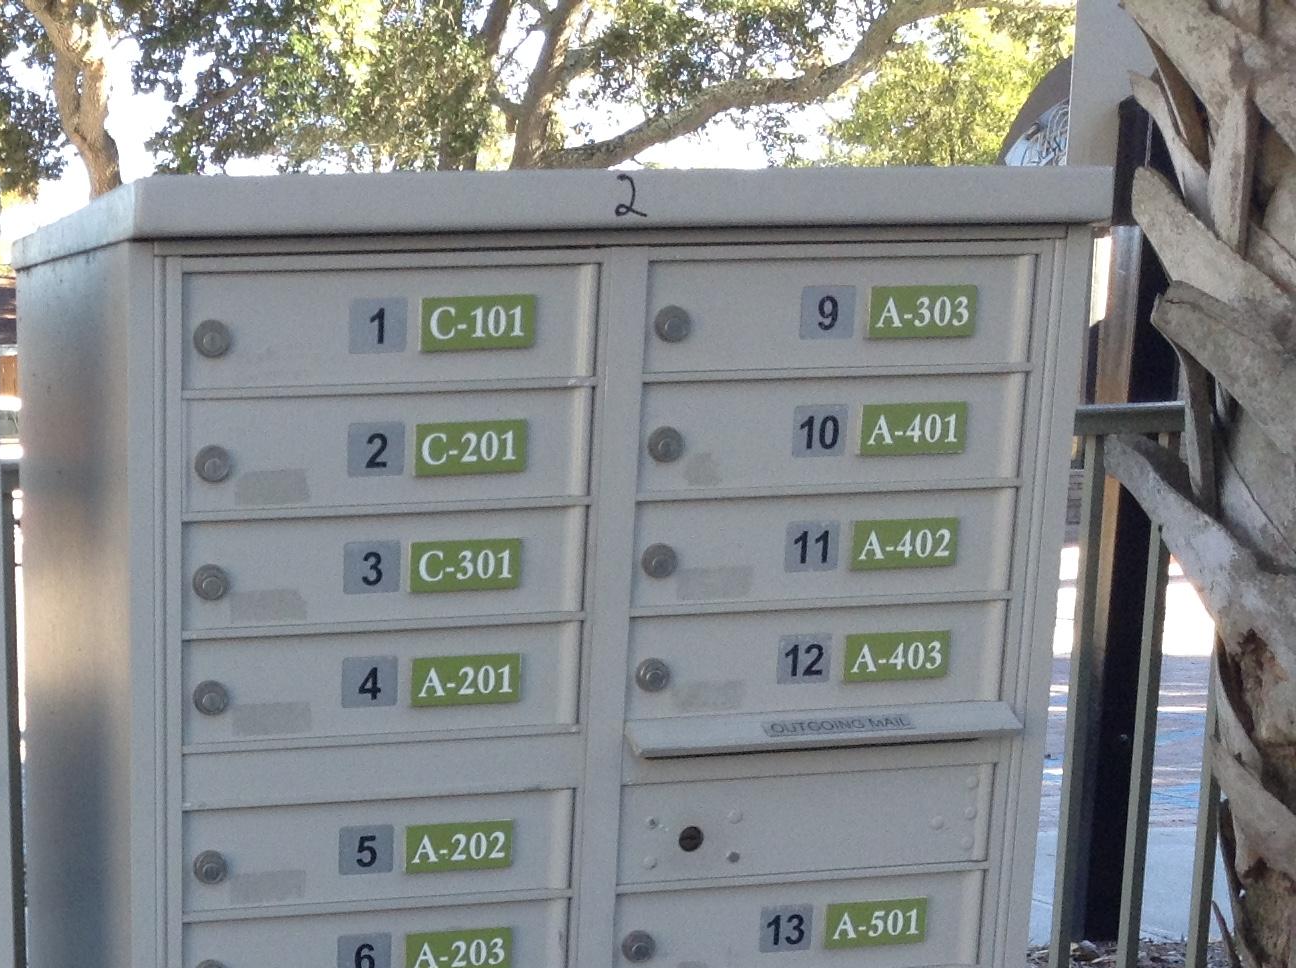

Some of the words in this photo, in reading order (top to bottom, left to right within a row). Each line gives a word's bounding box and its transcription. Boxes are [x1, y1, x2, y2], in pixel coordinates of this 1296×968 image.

[615, 173, 647, 217] 2
[369, 307, 385, 345] 1
[429, 305, 524, 340] C-101
[817, 295, 839, 331] 9
[876, 296, 969, 328] A-303
[799, 414, 840, 450] 10
[867, 413, 958, 445] A-401
[365, 432, 388, 469] 2
[421, 430, 516, 465] C-201
[793, 529, 830, 564] 11
[858, 528, 951, 560] A-402
[361, 551, 383, 587] 3
[418, 549, 512, 582] C-301
[784, 643, 824, 677] 12
[850, 640, 942, 673] A-403
[358, 666, 382, 701] 4
[418, 664, 513, 698] A-201
[770, 718, 864, 734] OUTGOING
[868, 716, 911, 729] MAIL
[356, 835, 378, 868] 5
[411, 831, 505, 864] A-202
[766, 913, 805, 946] 13
[832, 908, 919, 940] A-501
